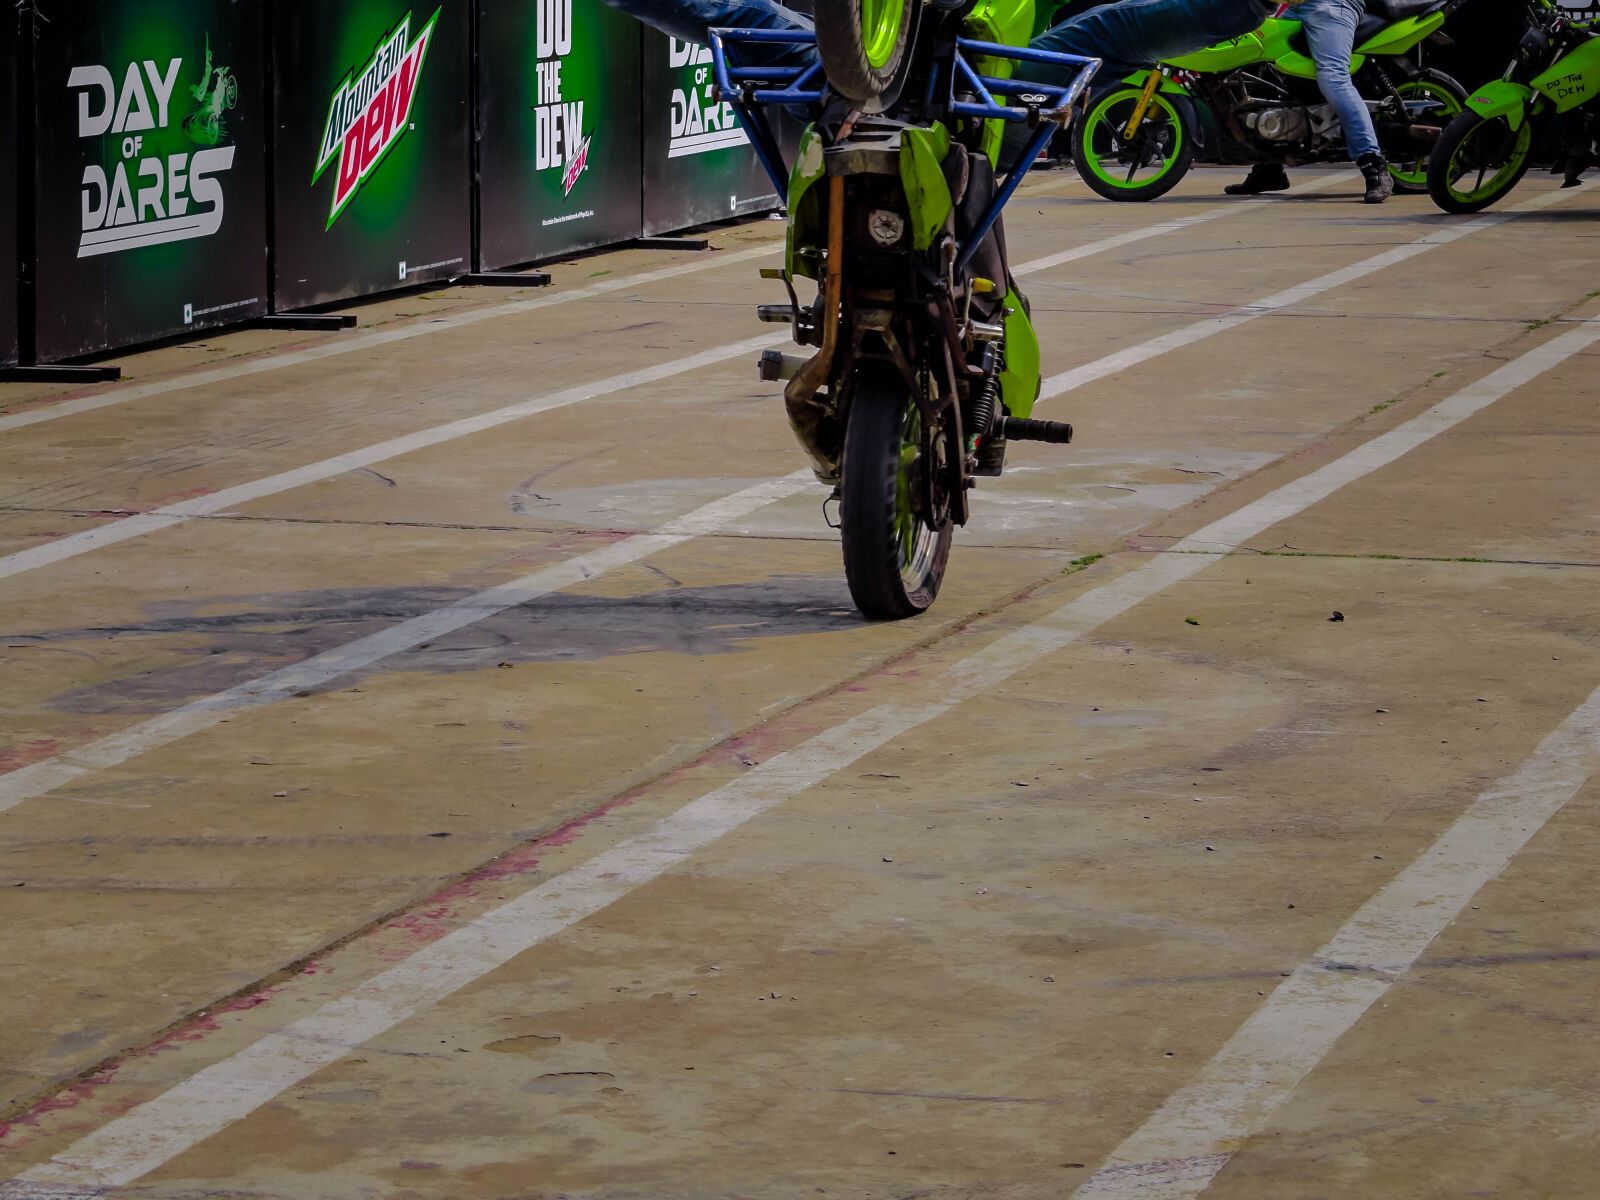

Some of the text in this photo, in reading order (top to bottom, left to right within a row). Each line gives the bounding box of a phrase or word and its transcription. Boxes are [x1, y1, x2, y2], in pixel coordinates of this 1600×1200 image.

[66, 57, 183, 138] DAY
[321, 25, 406, 163] Mountain
[536, 60, 562, 105] THE
[695, 67, 709, 85] OF
[1557, 84, 1585, 99] DEW
[122, 136, 143, 159] OF
[533, 100, 584, 171] DEW
[77, 145, 236, 258] DARES
